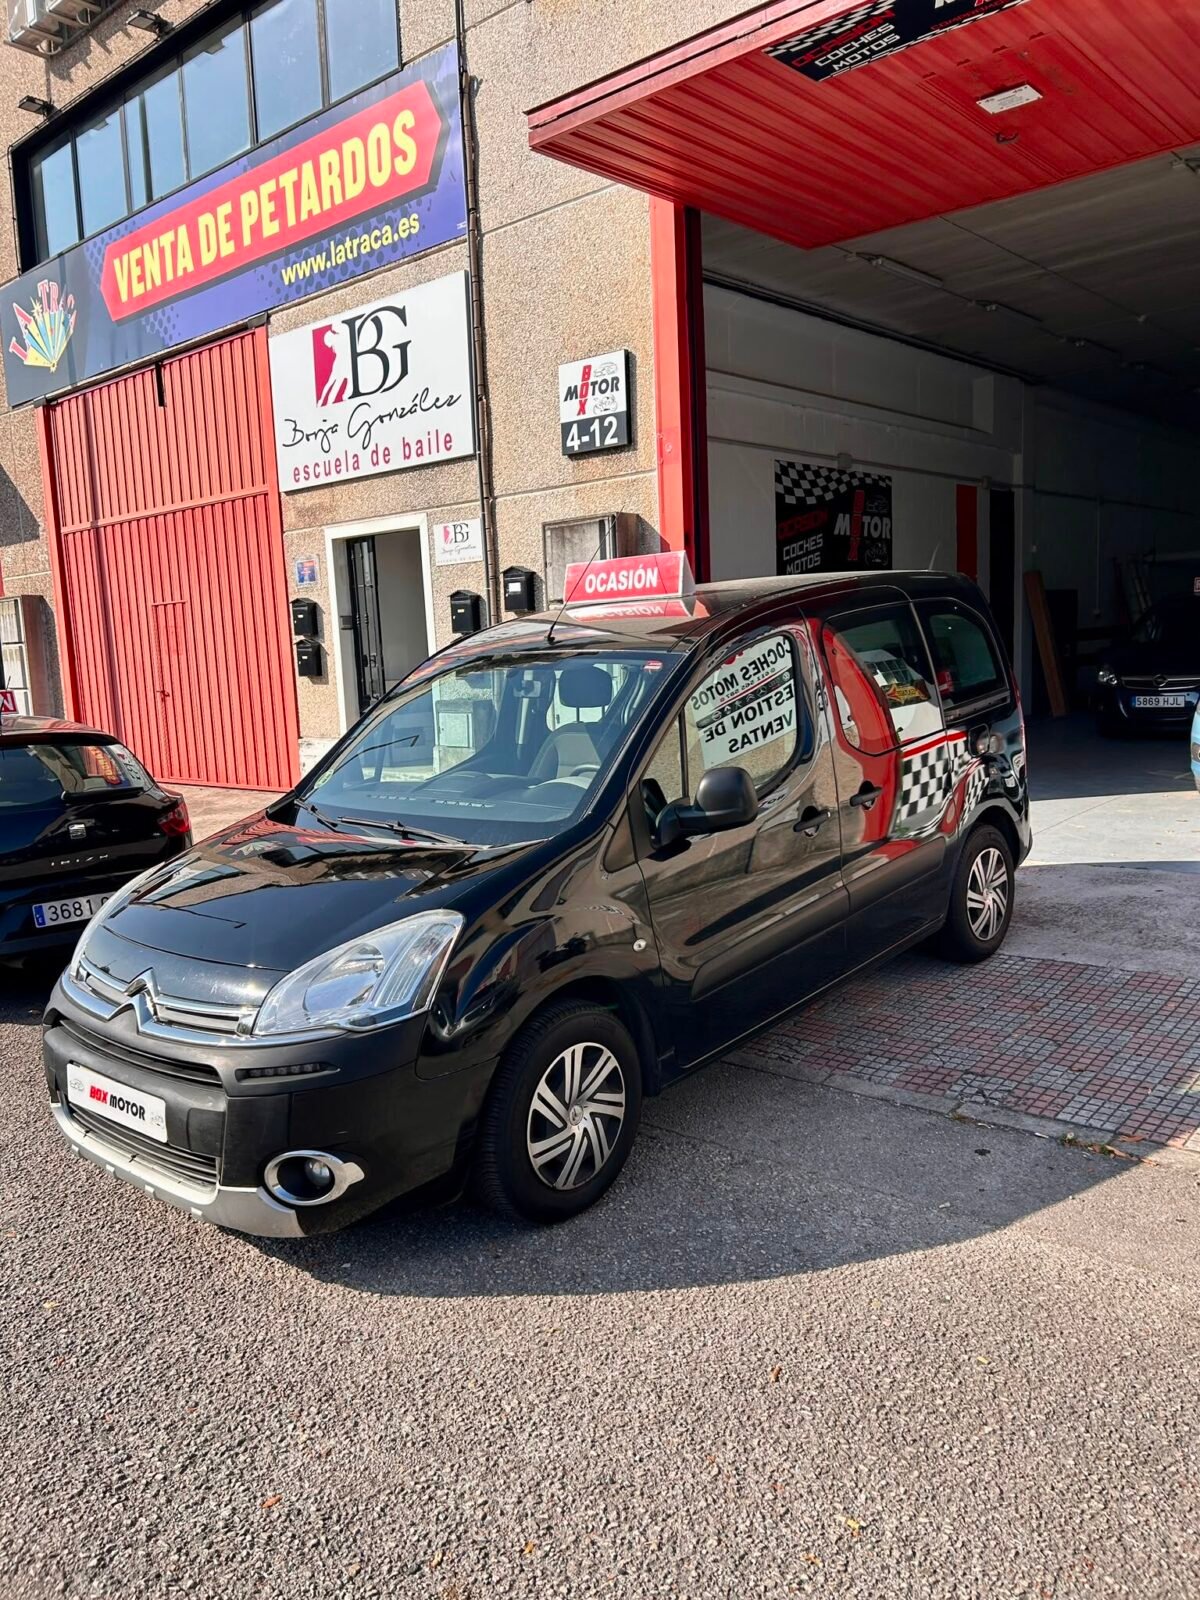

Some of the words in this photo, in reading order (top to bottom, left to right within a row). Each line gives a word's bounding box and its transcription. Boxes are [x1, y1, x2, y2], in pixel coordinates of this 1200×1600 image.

[814, 22, 895, 67] COCHES
[832, 33, 901, 71] MOTOS
[113, 223, 194, 304] VENTA
[197, 200, 235, 267] DE
[239, 109, 417, 248] PETARDOS
[281, 212, 420, 286] www.latraca.es
[564, 376, 619, 402] MOTOR
[577, 365, 592, 416] BOX
[282, 418, 339, 454] Borja
[347, 387, 462, 450] González
[566, 416, 618, 451] 4-12
[293, 450, 360, 483] escuela
[370, 443, 391, 467] de
[402, 429, 453, 460] baile
[783, 534, 823, 561] COCHES
[786, 551, 821, 575] MOTOS
[584, 563, 658, 594] OCASIÓN
[1136, 696, 1160, 706] 5869
[1163, 696, 1181, 706] HJL
[48, 899, 93, 922] 3681
[89, 1086, 109, 1104] BOX
[109, 1094, 145, 1120] MOTOR
